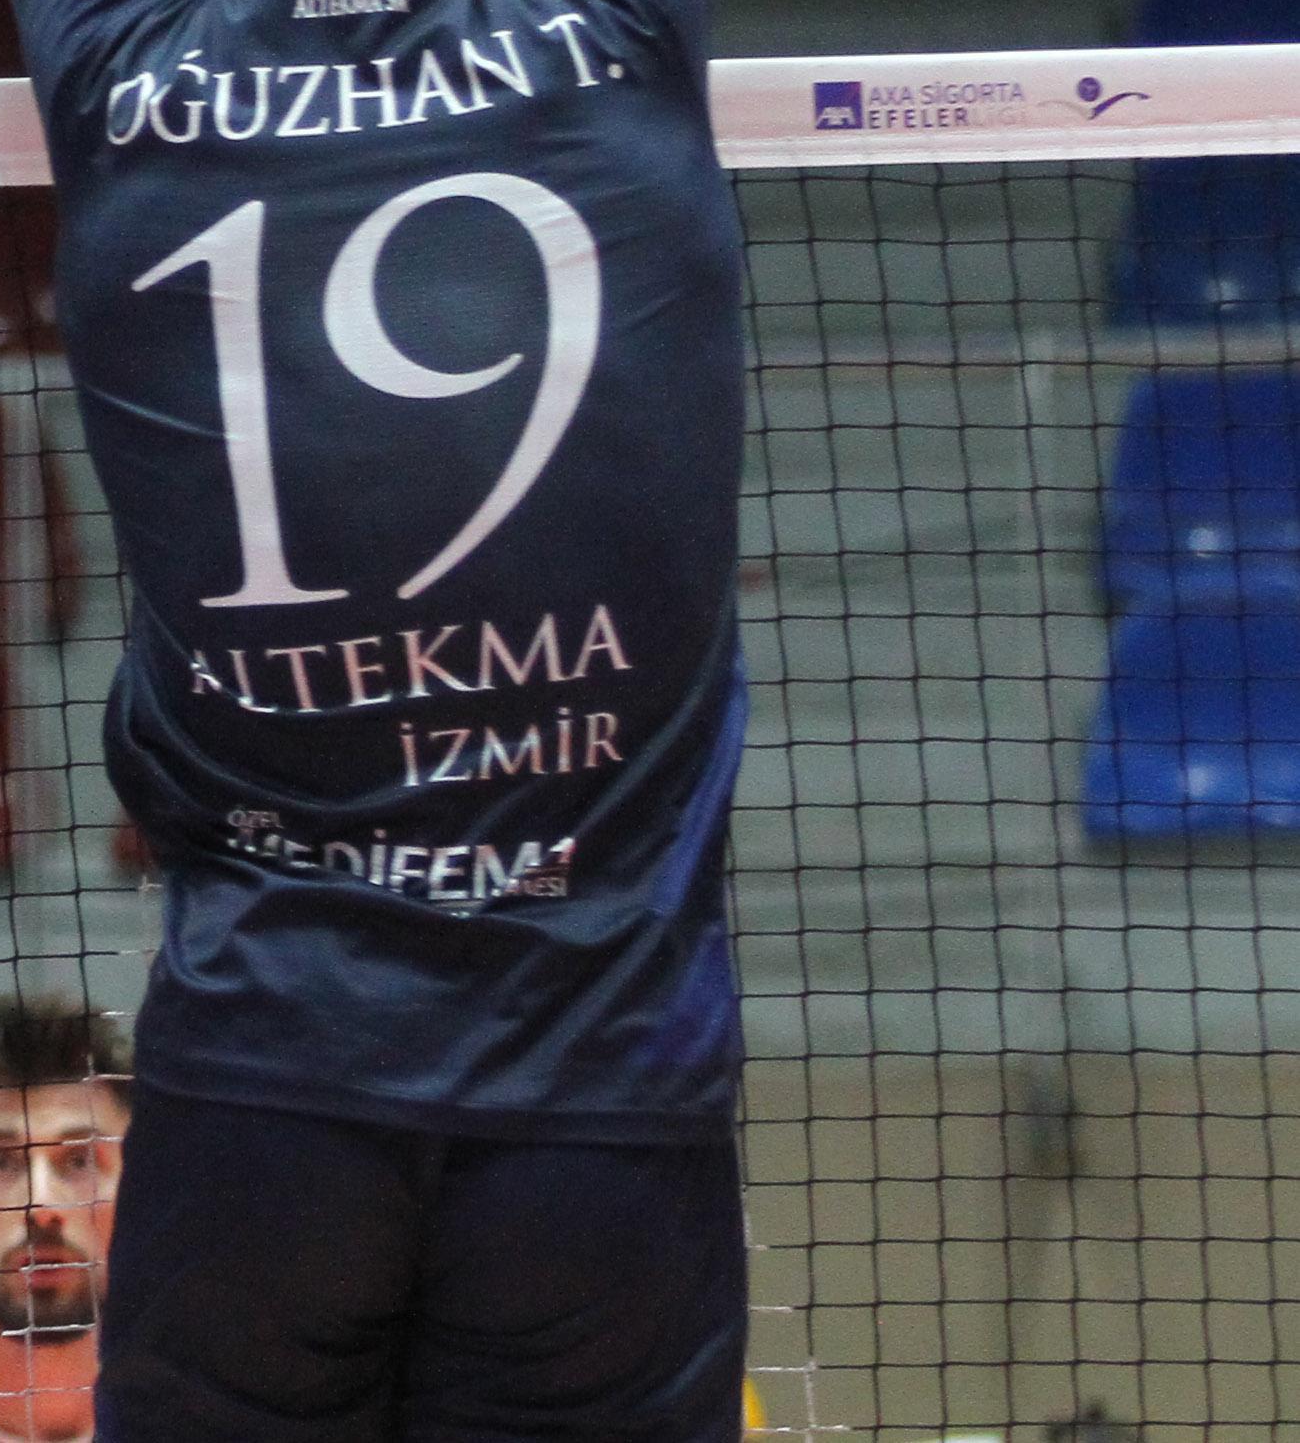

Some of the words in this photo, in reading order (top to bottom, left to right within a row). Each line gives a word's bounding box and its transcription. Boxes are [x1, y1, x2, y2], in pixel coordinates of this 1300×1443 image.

[106, 29, 534, 145] OĞUZHAN
[539, 13, 625, 88] T.
[869, 86, 915, 106] AXA
[869, 108, 969, 130] EFELER
[131, 172, 601, 608] 19
[401, 706, 624, 787] İZMİR
